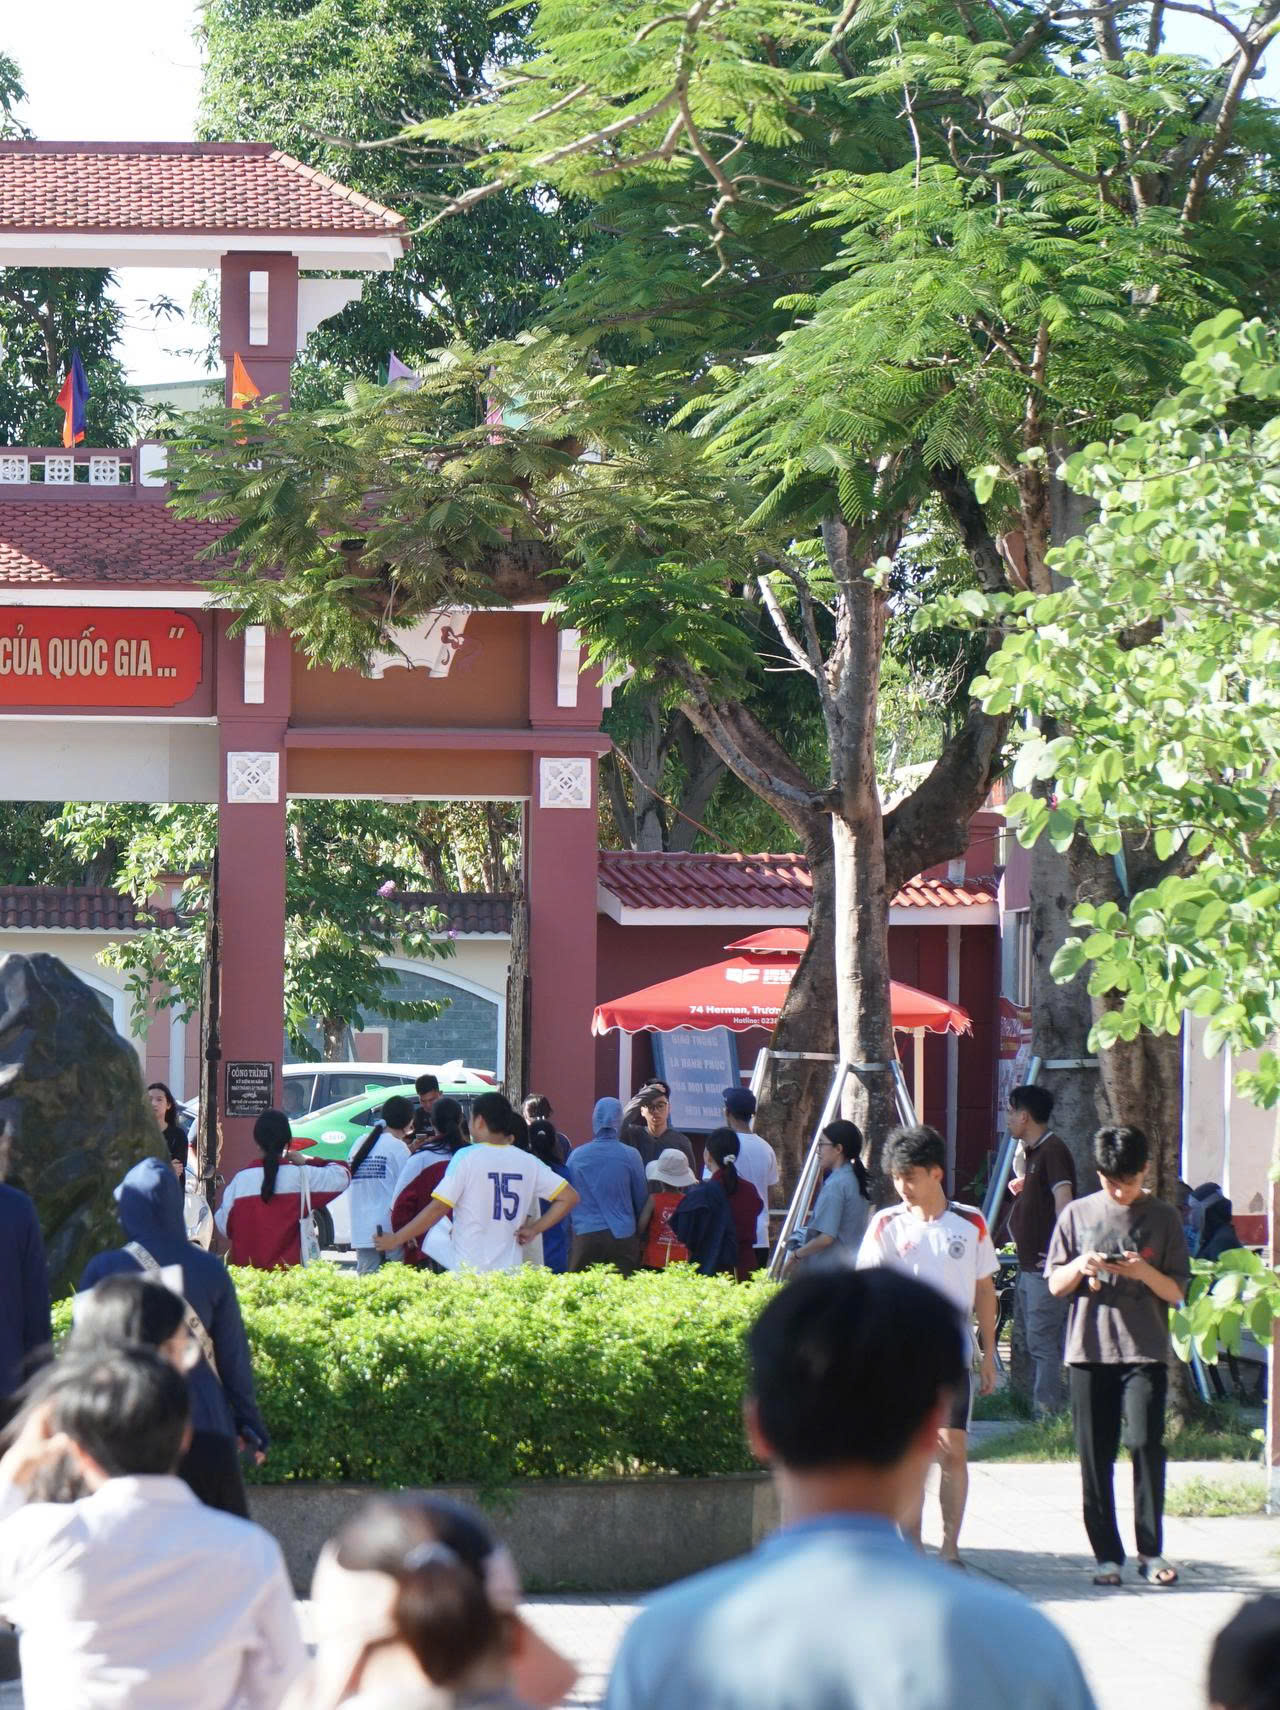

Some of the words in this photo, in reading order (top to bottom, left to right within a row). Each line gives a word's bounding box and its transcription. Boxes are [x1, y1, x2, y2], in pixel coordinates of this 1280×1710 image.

[48, 627, 108, 679] QUỐC
[689, 1005, 704, 1014] 74
[488, 1172, 523, 1221] 15
